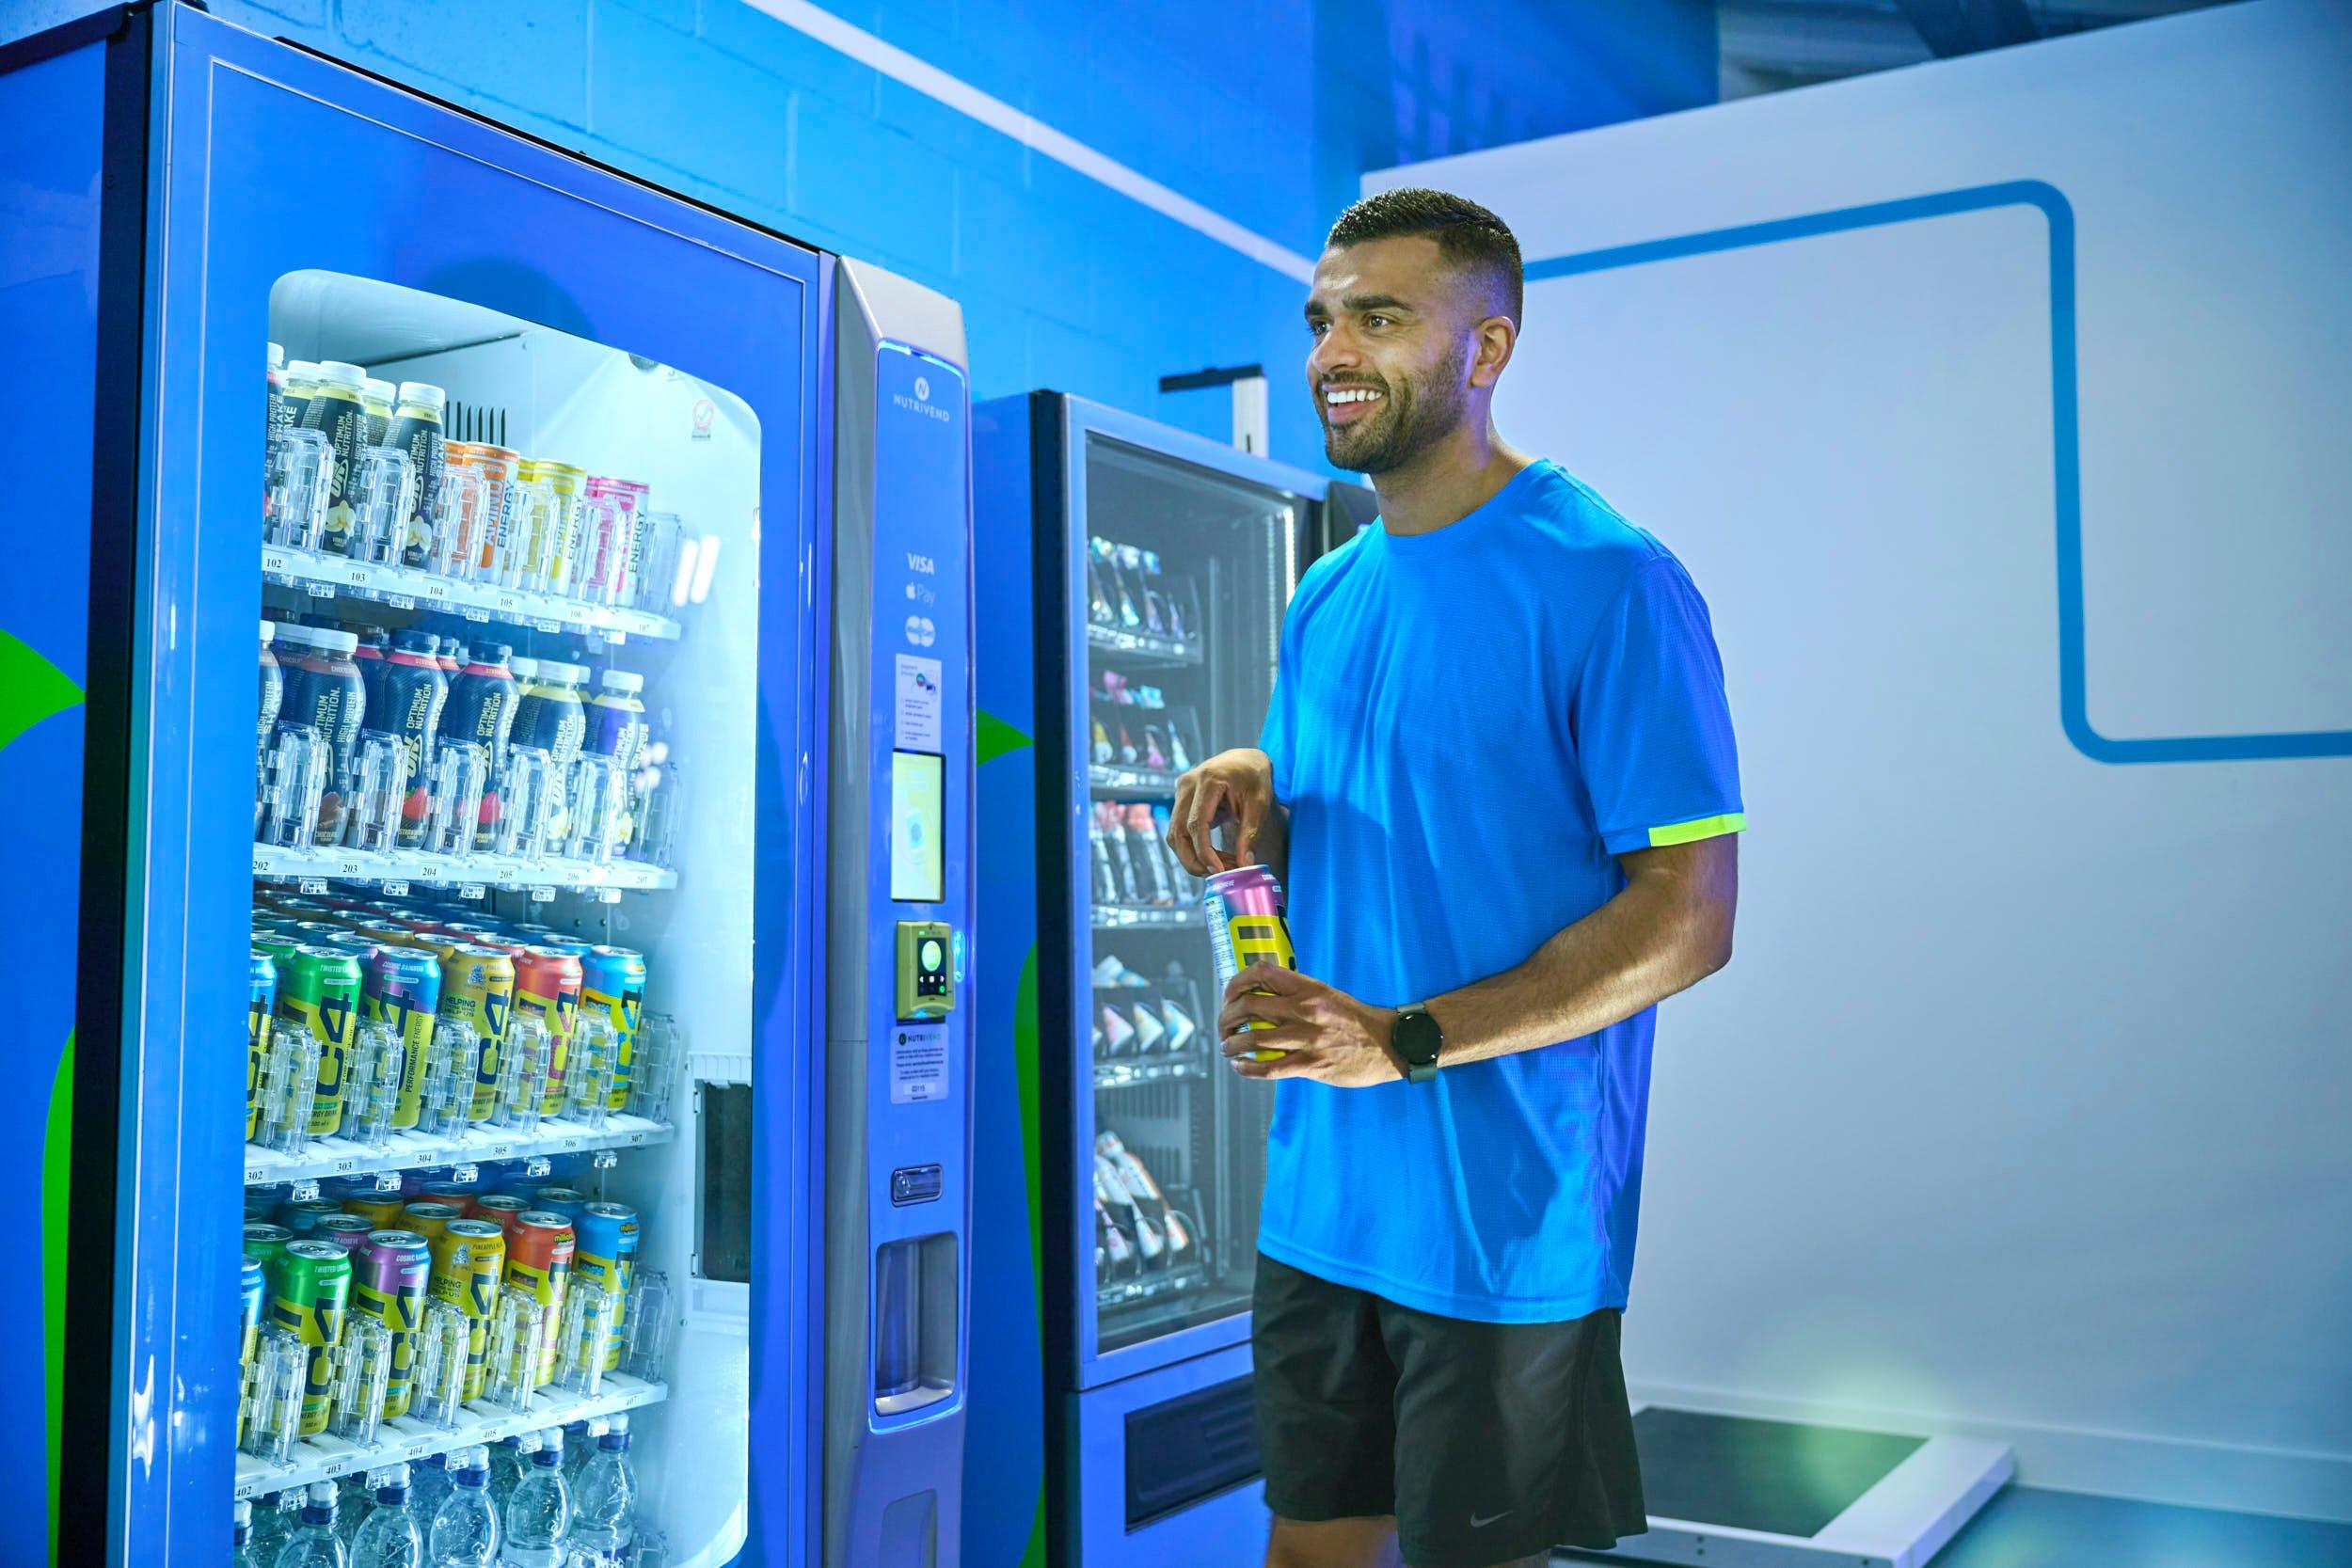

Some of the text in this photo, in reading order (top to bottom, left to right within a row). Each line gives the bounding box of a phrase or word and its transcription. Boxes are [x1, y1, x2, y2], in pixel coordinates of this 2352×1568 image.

[893, 393, 949, 421] NUTRIVEND
[497, 481, 515, 548] ENERGY
[628, 510, 646, 574] ENERGY
[265, 558, 283, 568] 102
[906, 551, 935, 575] VISA
[351, 572, 366, 581] 103
[429, 585, 444, 595] 104
[500, 598, 513, 609] 105
[406, 688, 423, 729] OPTIMUM
[414, 683, 433, 731] NUTRITION
[476, 697, 493, 736] OPTIMUM
[485, 692, 502, 737] NUTRITION
[253, 860, 269, 871] 202
[342, 863, 358, 874] 203
[422, 867, 437, 877] 204
[499, 870, 513, 879] 205
[477, 990, 509, 1085] C4
[315, 991, 353, 1097] C4
[405, 1039, 420, 1093] PERFORMANCE
[564, 1139, 577, 1148] 306
[629, 1134, 644, 1144] 307
[493, 1146, 508, 1156] 305
[417, 1154, 433, 1164] 304
[336, 1162, 352, 1172] 303
[246, 1171, 263, 1181] 302
[483, 1429, 498, 1439] 405
[407, 1448, 423, 1457] 404
[326, 1465, 342, 1475] 403
[235, 1485, 252, 1497] 402
